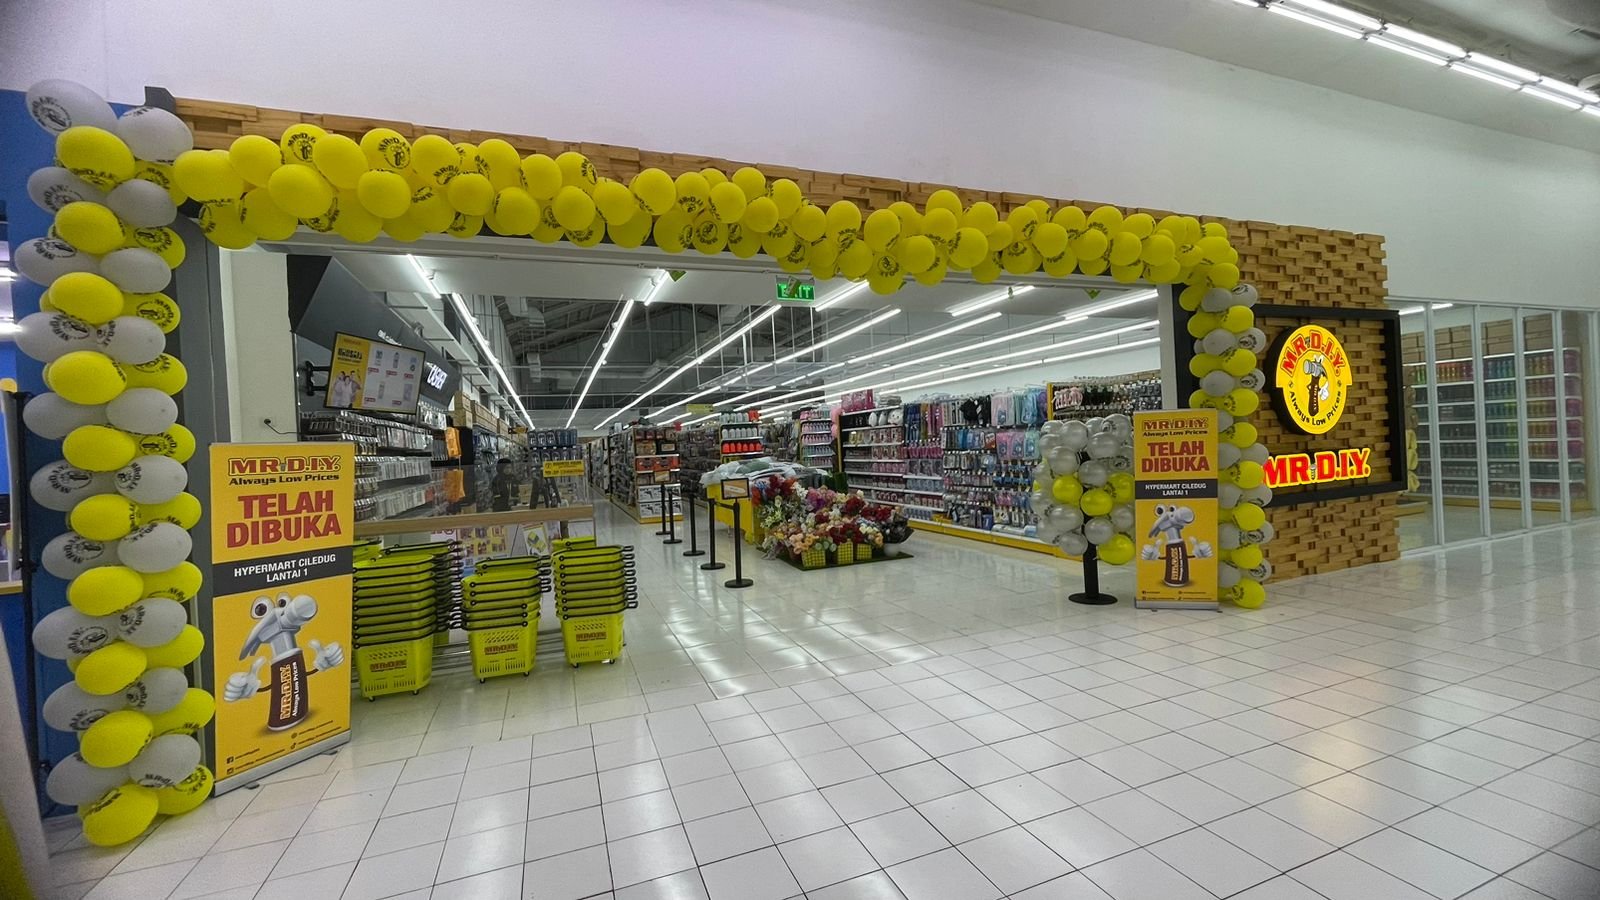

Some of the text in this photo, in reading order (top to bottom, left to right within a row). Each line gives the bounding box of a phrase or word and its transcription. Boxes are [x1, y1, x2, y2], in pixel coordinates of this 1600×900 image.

[779, 284, 811, 298] EIT
[1289, 390, 1342, 426] Always Low Prices
[1147, 440, 1205, 456] TELAH
[1141, 456, 1210, 472] DIBUKA
[229, 476, 276, 486] Always
[279, 475, 302, 483] Low
[238, 490, 334, 519] TELAH
[227, 514, 341, 548] DIBUKA
[234, 554, 336, 577] HYPERMART CILEDUG
[266, 568, 308, 583] LANTAI 1
